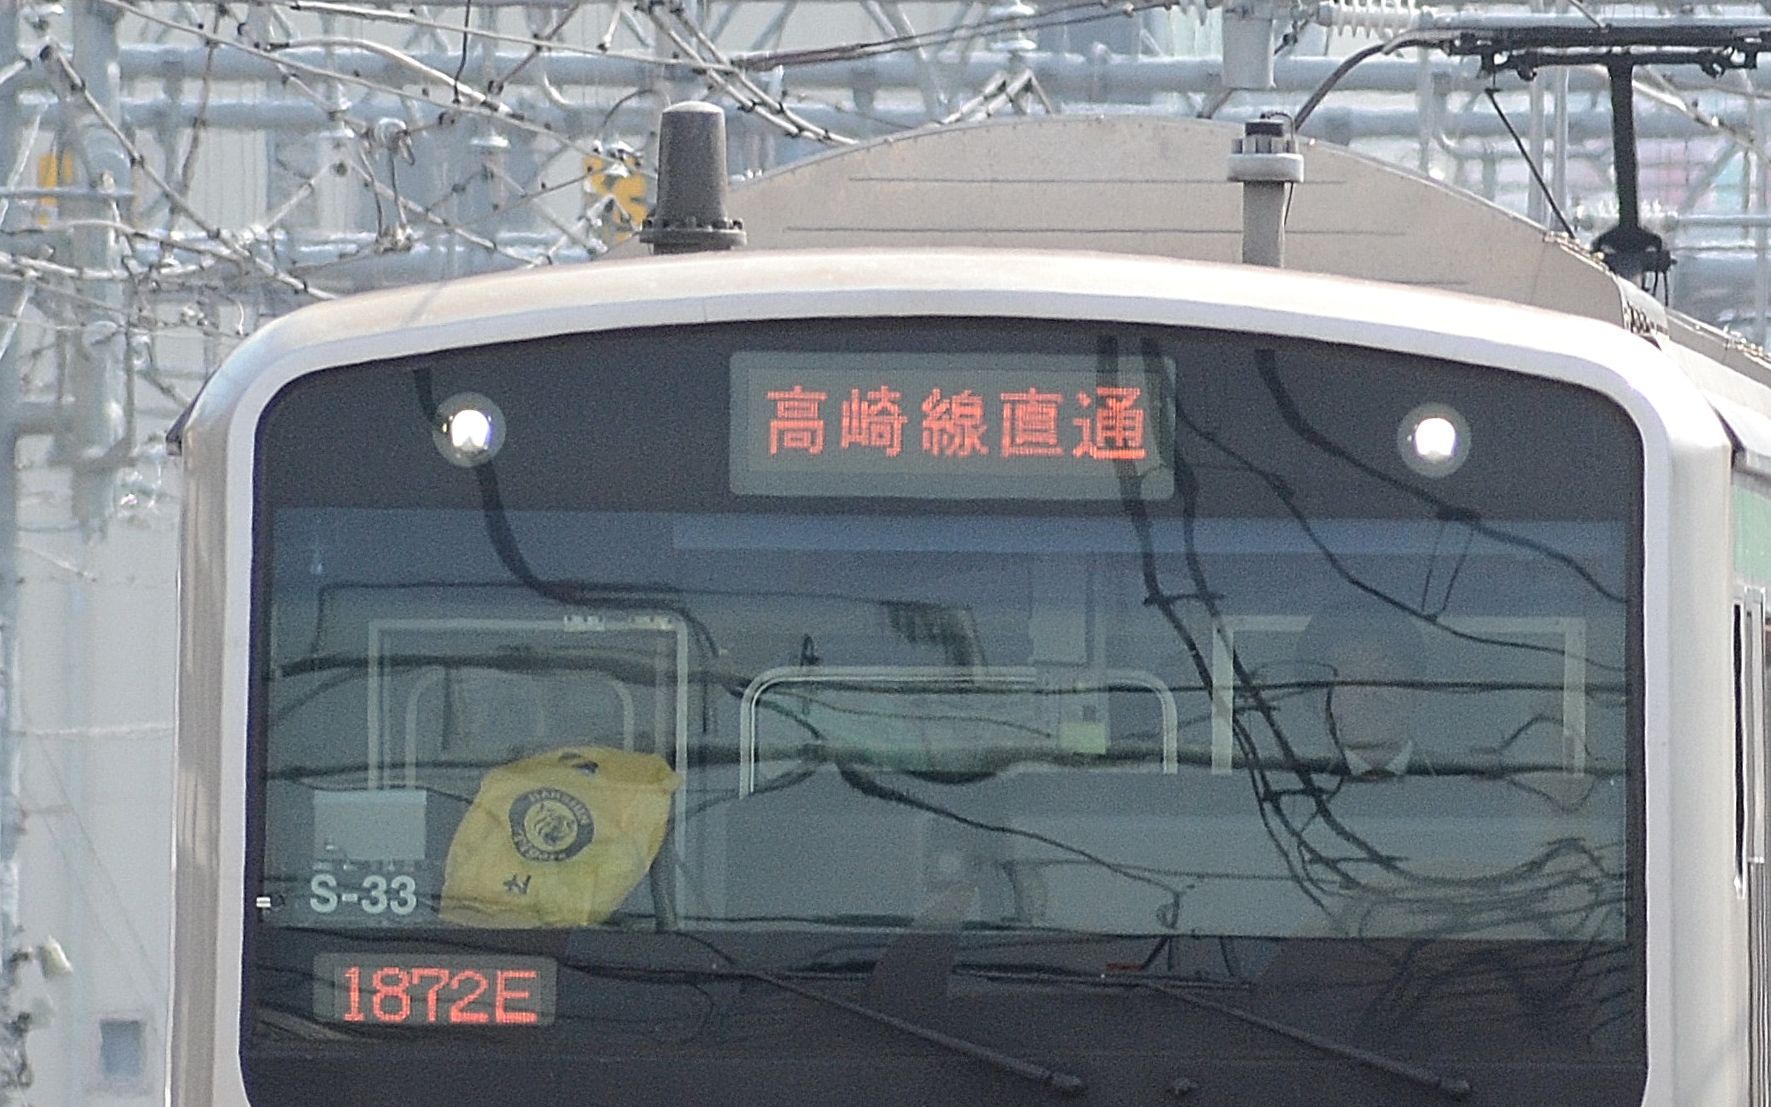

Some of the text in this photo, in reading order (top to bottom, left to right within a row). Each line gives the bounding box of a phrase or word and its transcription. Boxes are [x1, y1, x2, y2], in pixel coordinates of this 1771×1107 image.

[766, 385, 1148, 460] 高崎線直通
[309, 873, 417, 915] S-33
[342, 965, 539, 1025] 1872E
